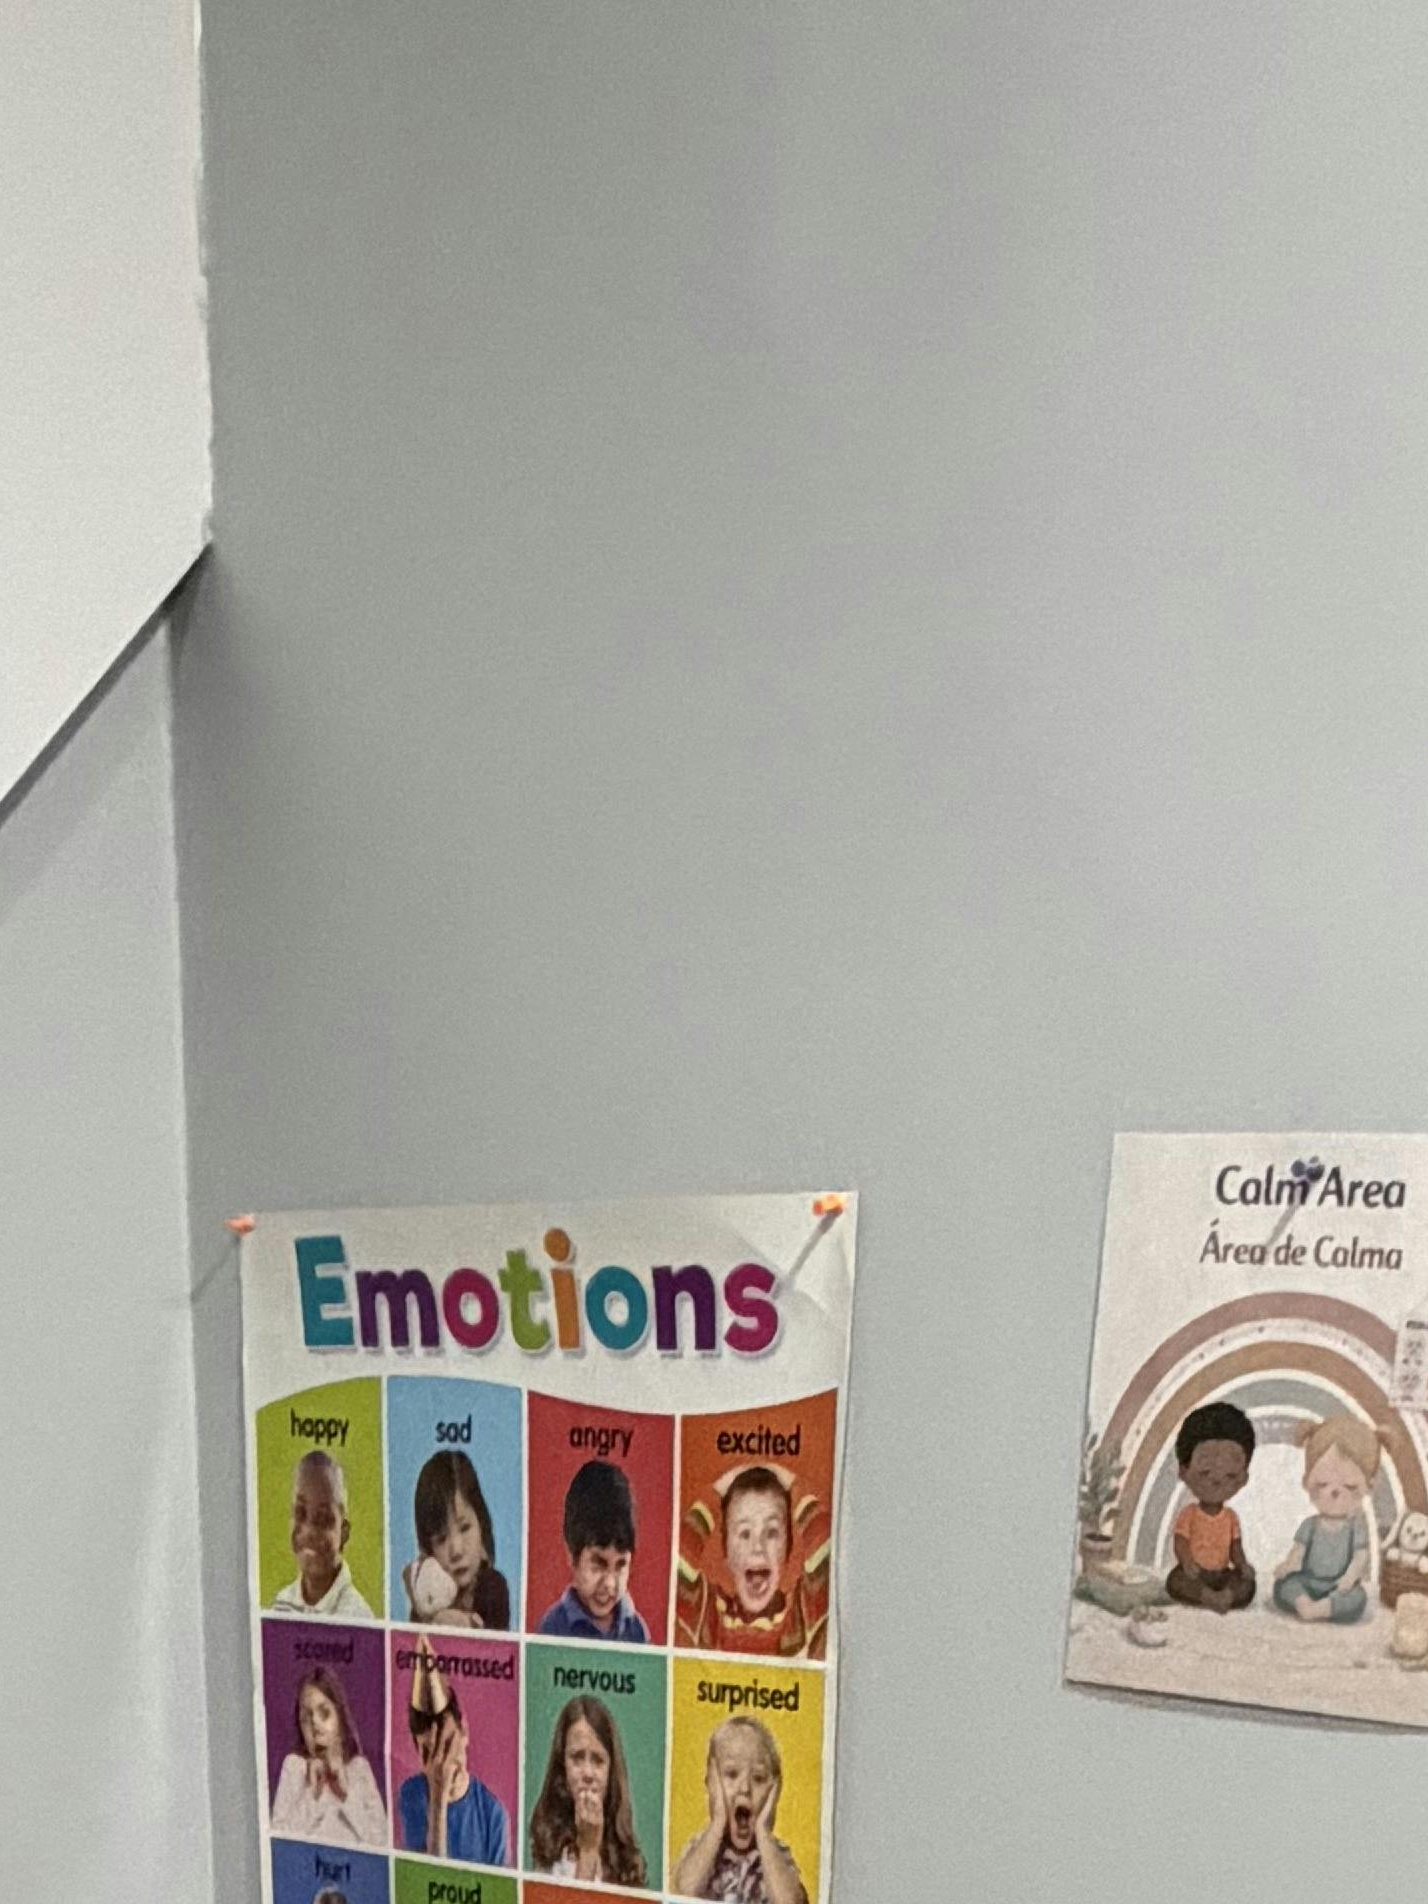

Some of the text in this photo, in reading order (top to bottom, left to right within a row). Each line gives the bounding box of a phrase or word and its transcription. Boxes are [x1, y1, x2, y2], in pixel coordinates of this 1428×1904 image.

[1216, 1163, 1406, 1209] Calm Area
[1199, 1217, 1403, 1270] Área de Calma
[293, 1227, 779, 1352] Emotions
[290, 1409, 349, 1445] happy
[435, 1414, 472, 1444] sad
[569, 1423, 635, 1457] angry
[716, 1425, 801, 1457] excited
[293, 1638, 355, 1663] scared
[395, 1649, 515, 1680] embarrassed
[553, 1663, 636, 1694] nervous
[696, 1677, 800, 1711] surprised
[315, 1852, 351, 1882] hurt
